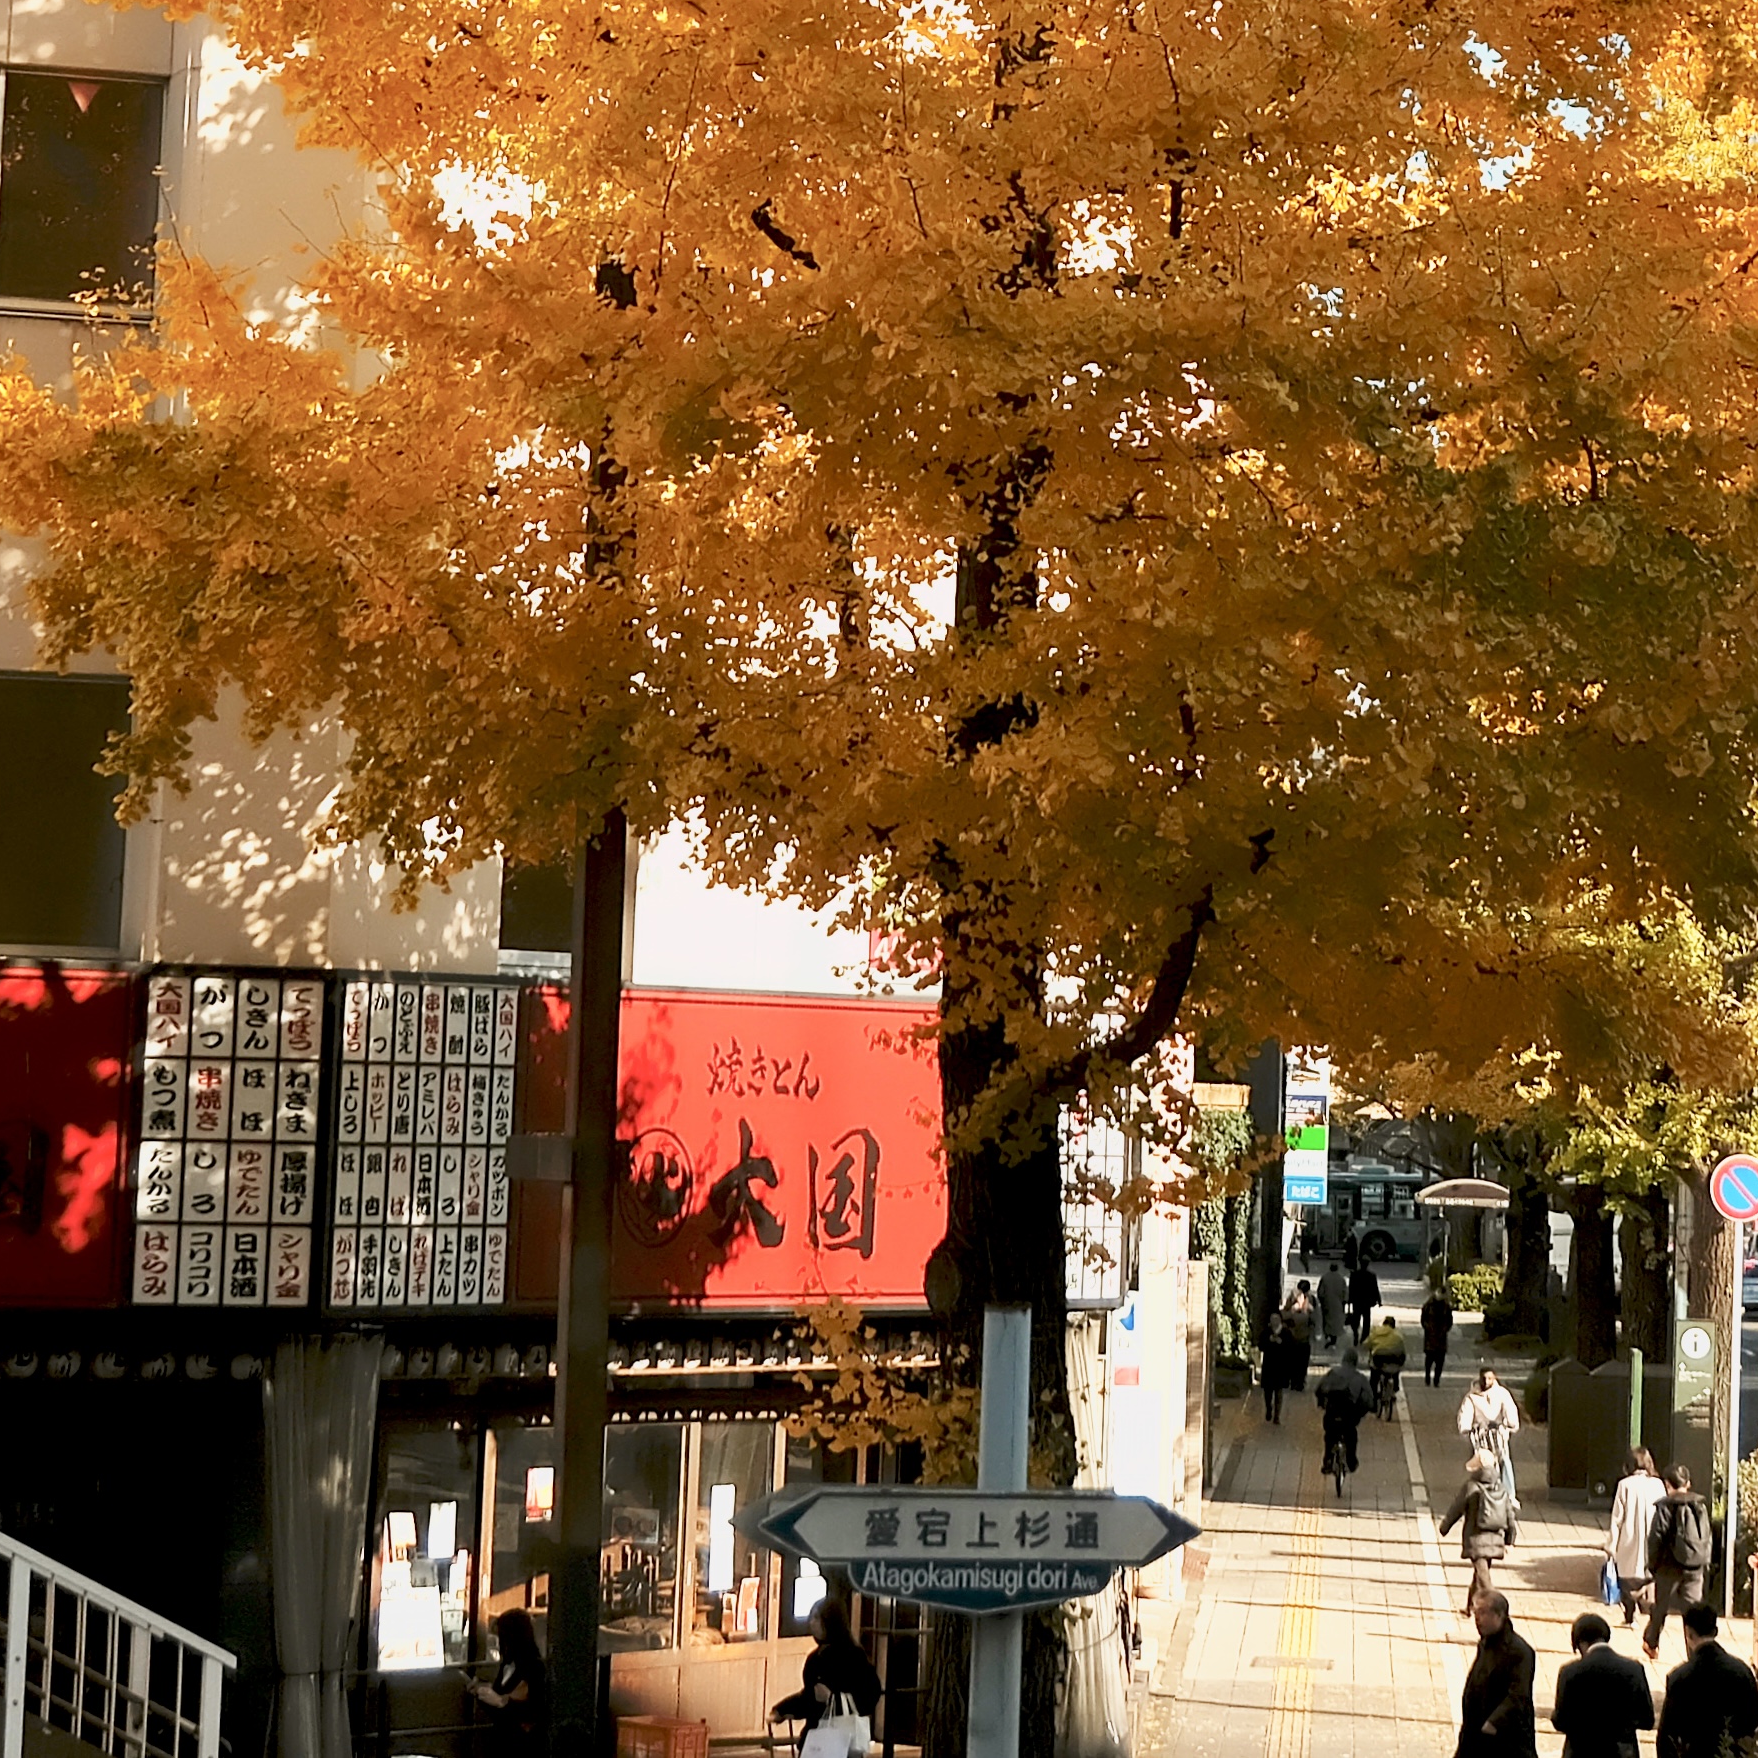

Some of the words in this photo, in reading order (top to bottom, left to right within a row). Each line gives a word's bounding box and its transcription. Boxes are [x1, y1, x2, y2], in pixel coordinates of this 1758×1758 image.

[156, 982, 182, 1049] 大国ハイ
[424, 993, 441, 1055] 串焼き
[473, 995, 490, 1057] 豚ばら
[498, 995, 514, 1058] 大国ハイ
[195, 1068, 222, 1131] 串焼き
[706, 1036, 822, 1102] 焼きとん
[342, 1071, 359, 1134] 上しろ
[419, 1072, 437, 1136] アミレバ
[445, 1073, 462, 1135] はらみ
[142, 1231, 169, 1296] はらみ
[230, 1233, 258, 1298] 日本酒
[438, 1234, 453, 1299] 上たん
[462, 1234, 478, 1299] 串カツ
[864, 1506, 1100, 1548] 愛宕上杉通
[862, 1561, 1024, 1597] Atagokamisugi
[1027, 1561, 1068, 1590] dori
